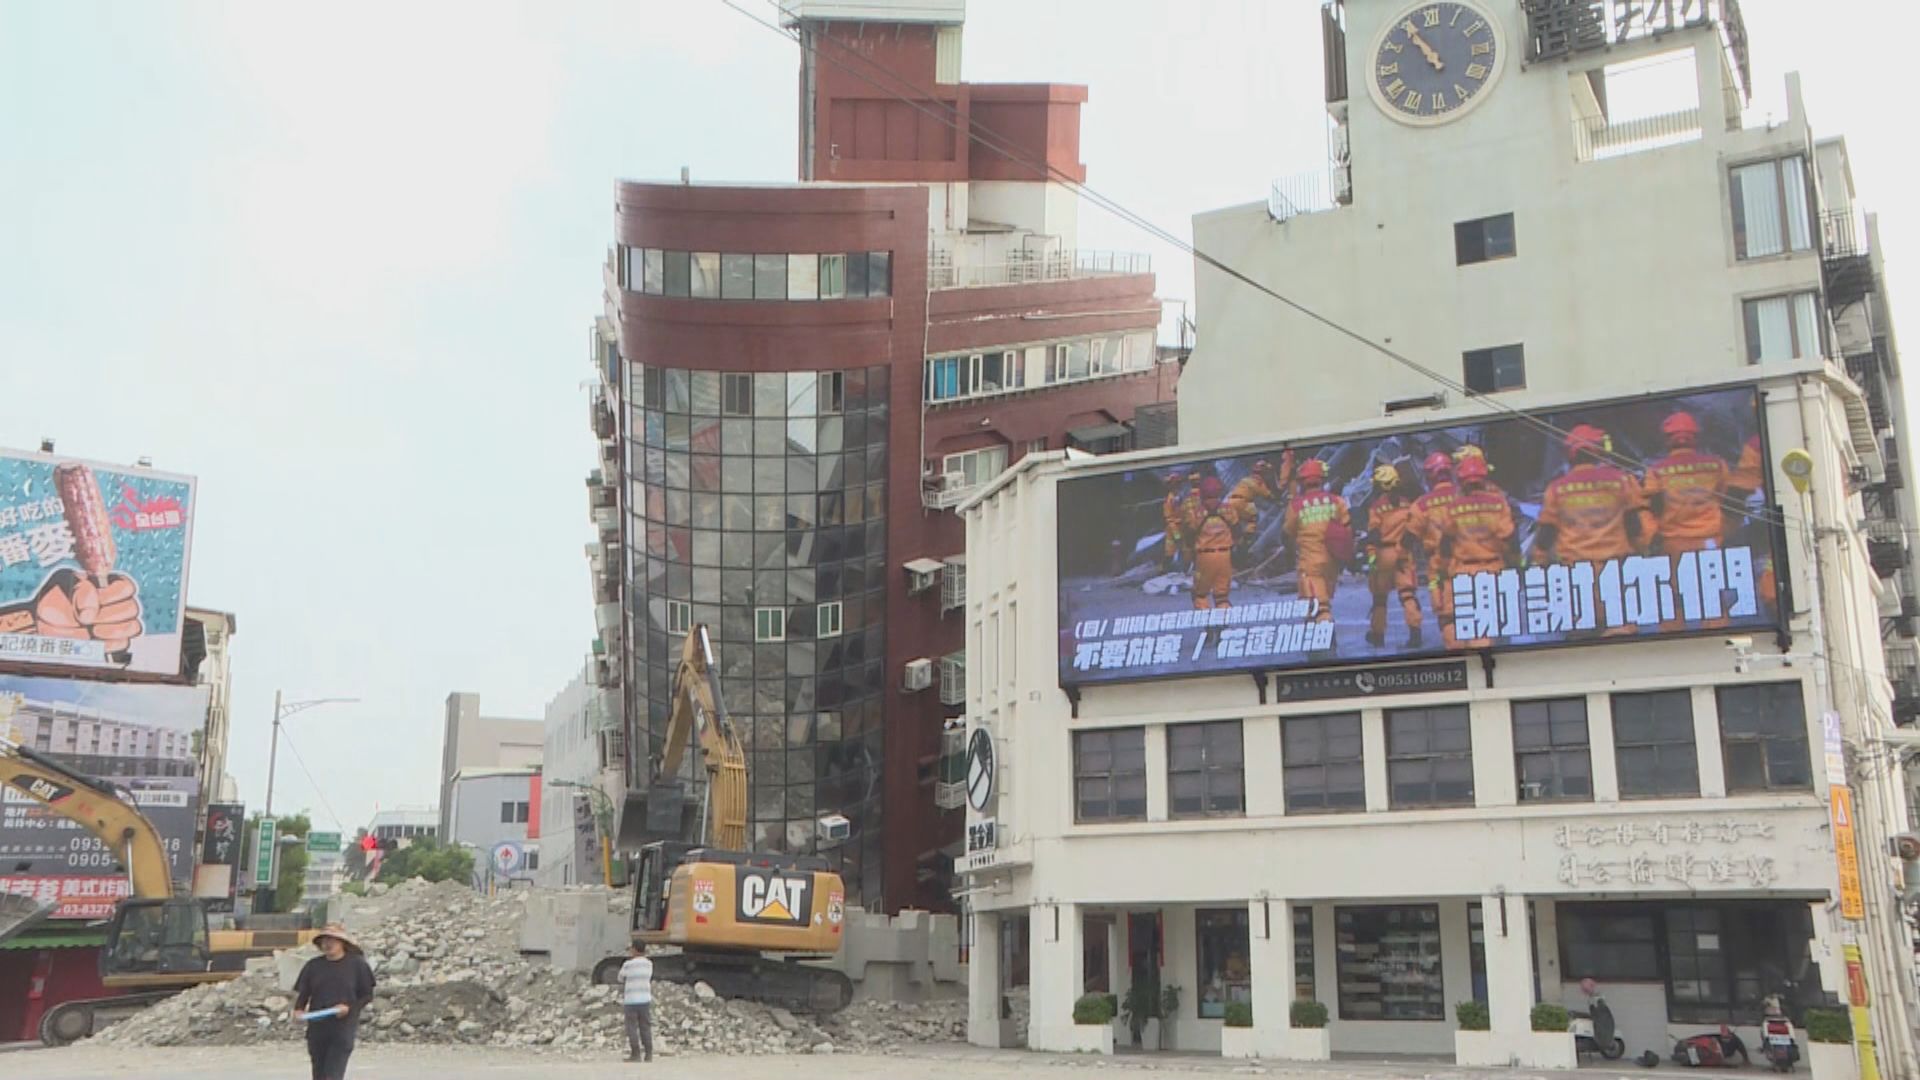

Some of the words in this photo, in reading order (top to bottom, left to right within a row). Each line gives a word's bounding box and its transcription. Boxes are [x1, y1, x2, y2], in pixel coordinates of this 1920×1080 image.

[1452, 547, 1757, 640] 謝謝你們
[1072, 634, 1182, 671] 不要放棄
[1217, 620, 1335, 659] 花蓮加油
[1378, 670, 1462, 687] 0955109812
[30, 779, 59, 799] CAT
[743, 875, 806, 920] CAT
